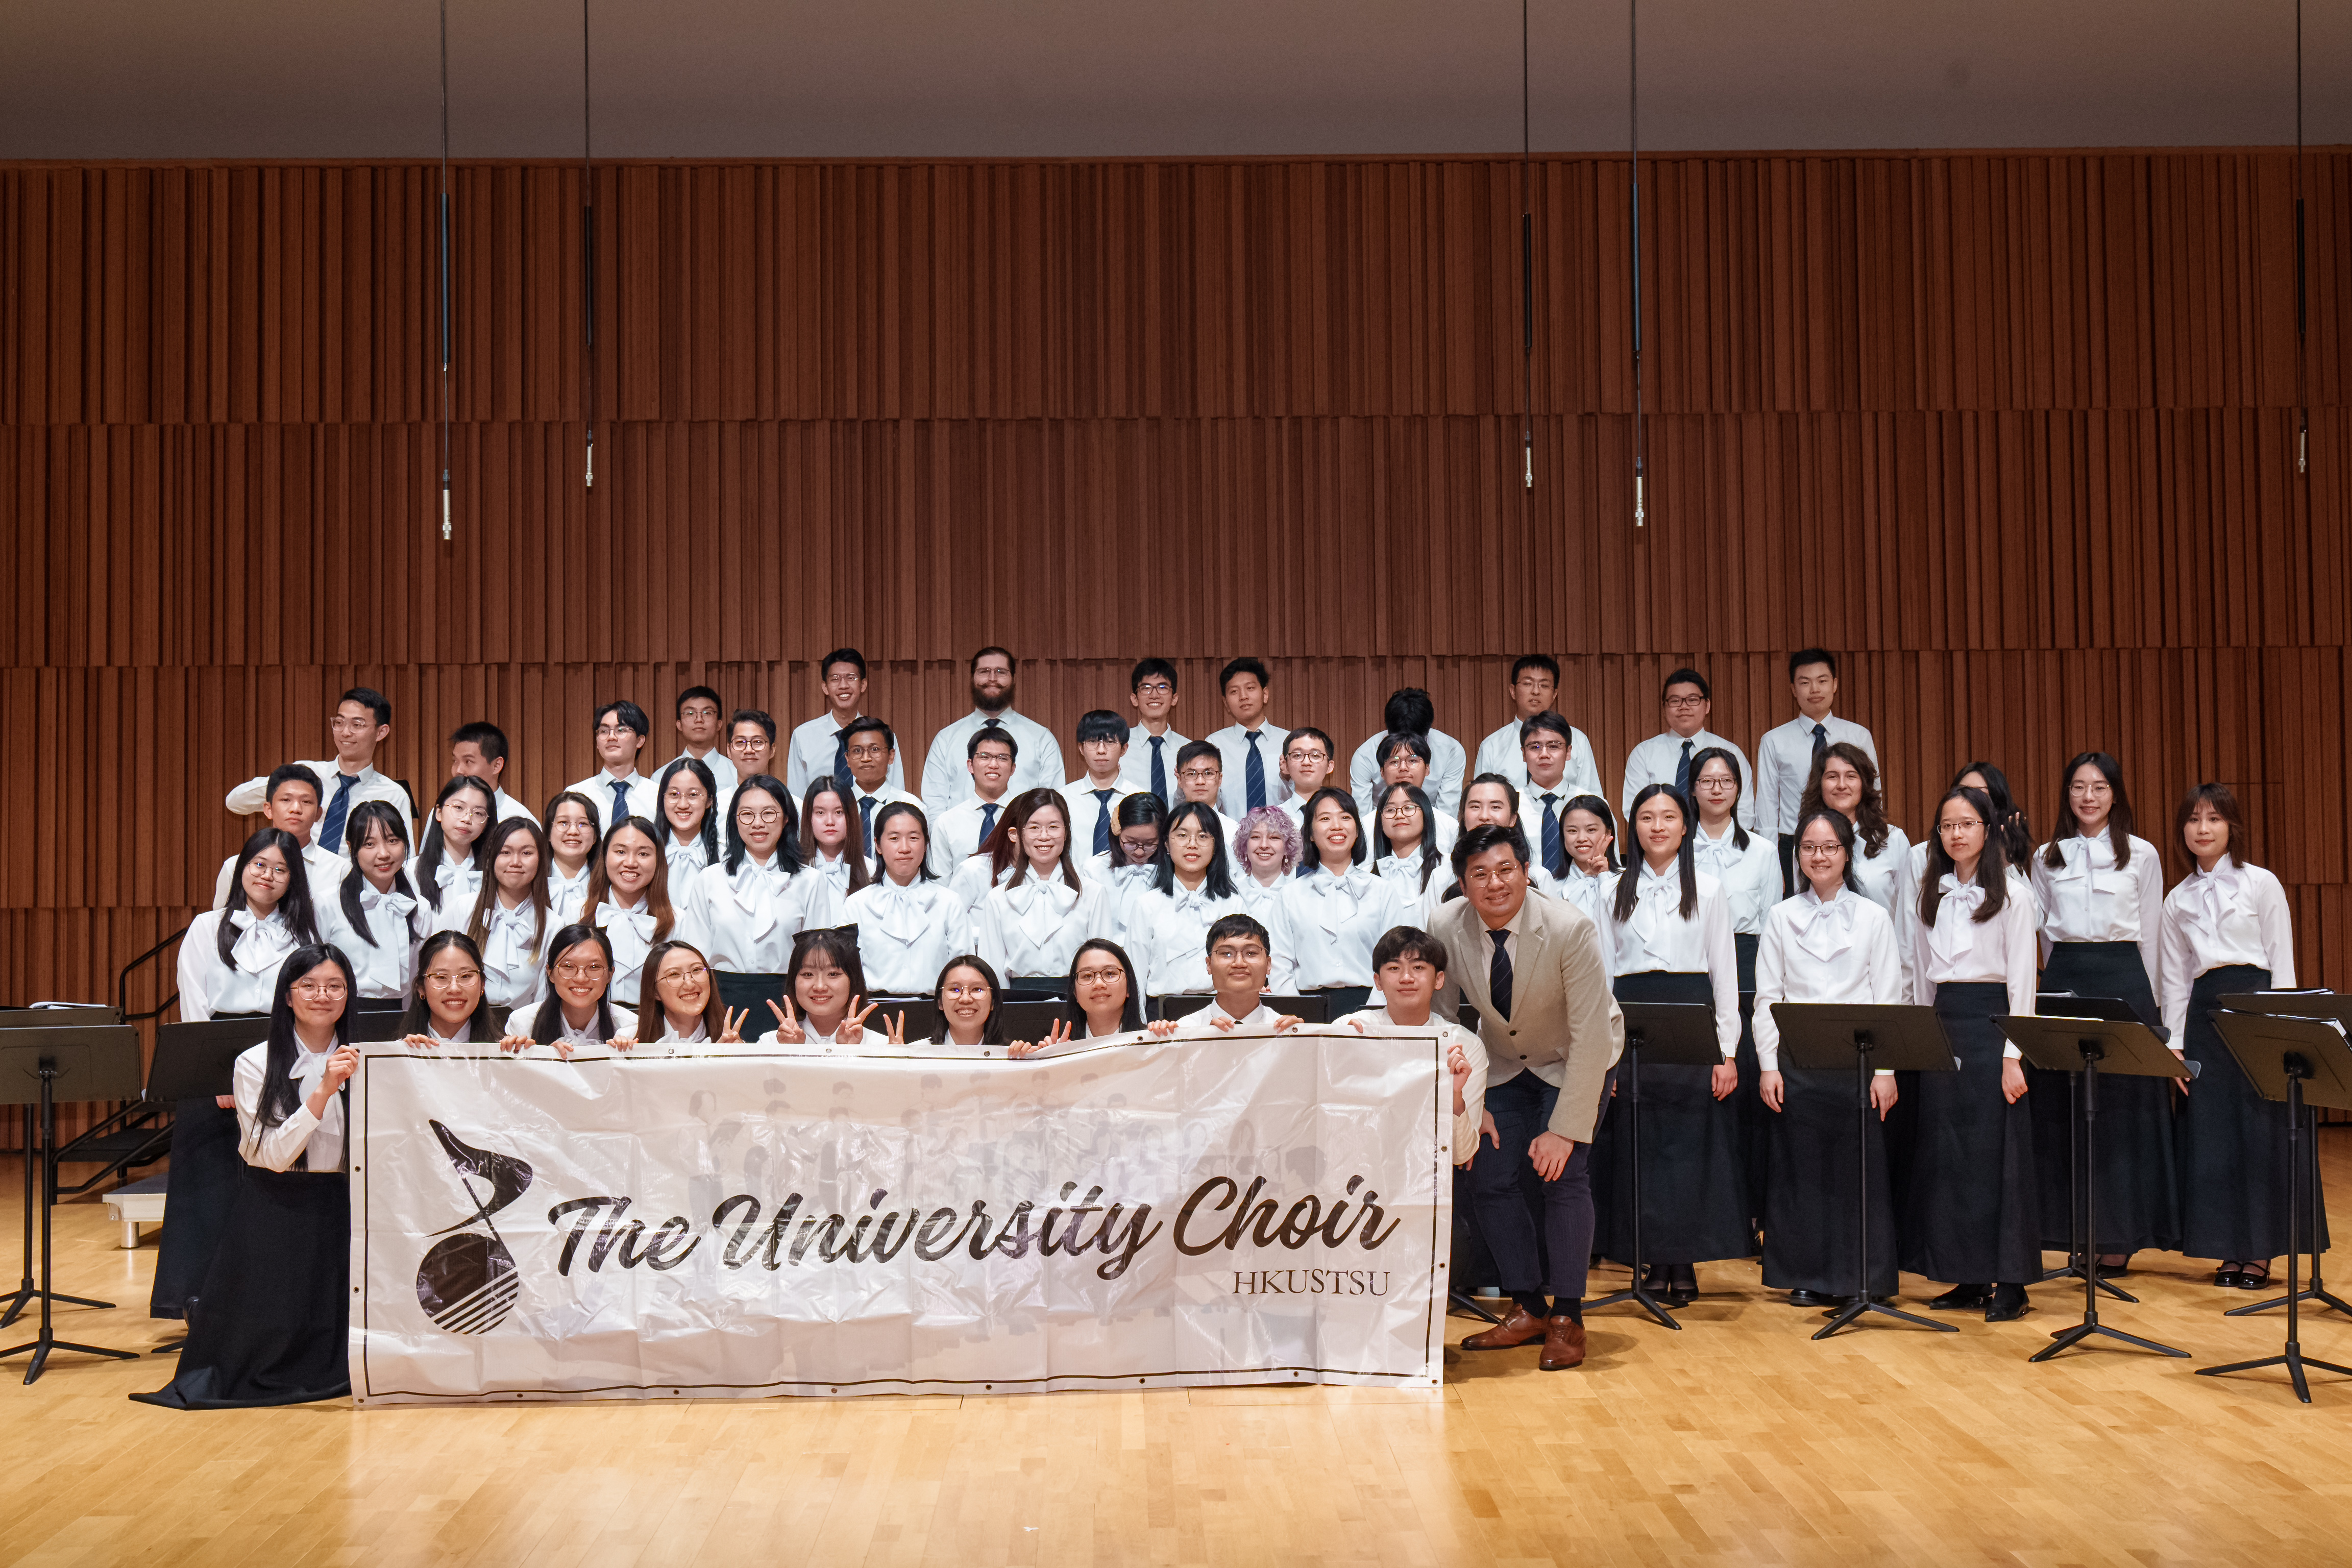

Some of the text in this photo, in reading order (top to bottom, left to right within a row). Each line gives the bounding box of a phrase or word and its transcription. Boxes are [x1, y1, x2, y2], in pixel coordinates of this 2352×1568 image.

[548, 1174, 1401, 1280] The University Choir
[1232, 1269, 1390, 1296] HKUSTSU
